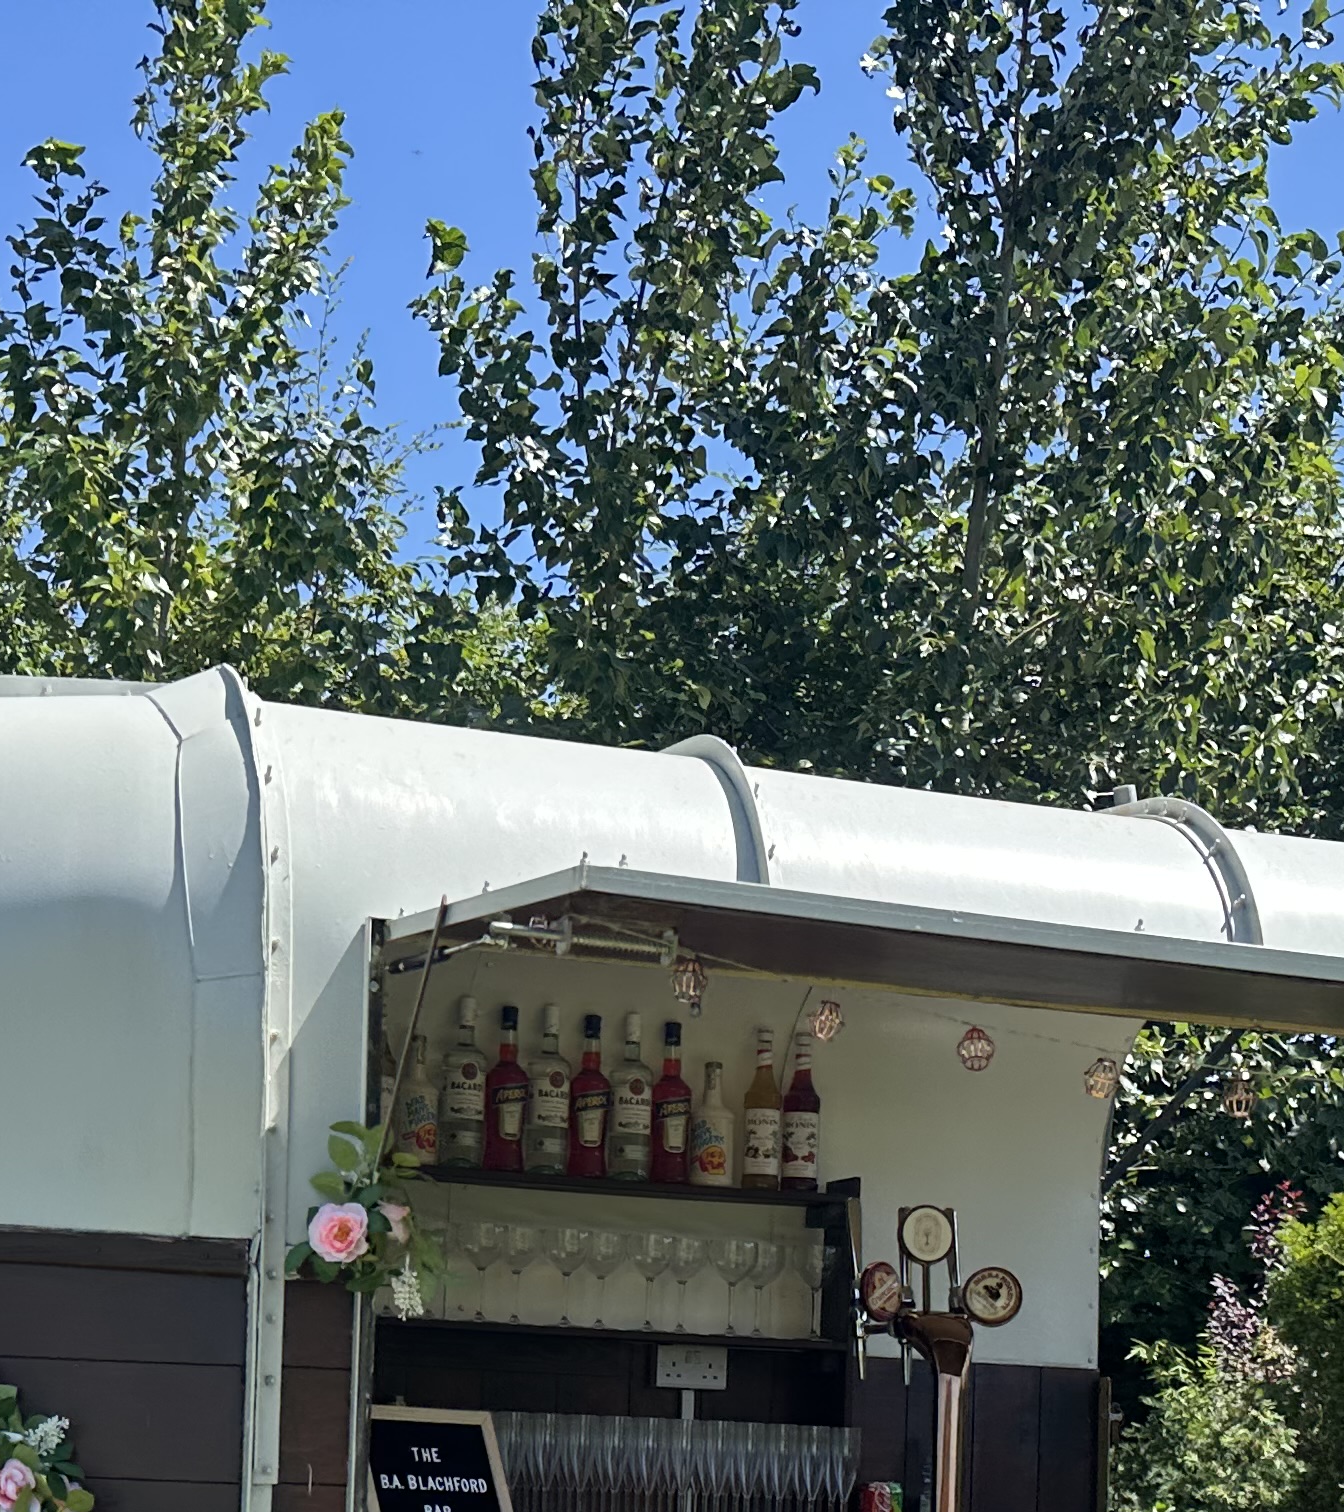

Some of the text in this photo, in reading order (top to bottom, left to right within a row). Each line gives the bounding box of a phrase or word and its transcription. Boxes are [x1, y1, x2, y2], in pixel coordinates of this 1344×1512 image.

[411, 1447, 441, 1463] THE
[380, 1474, 487, 1493] B.A. BLACHFORD
